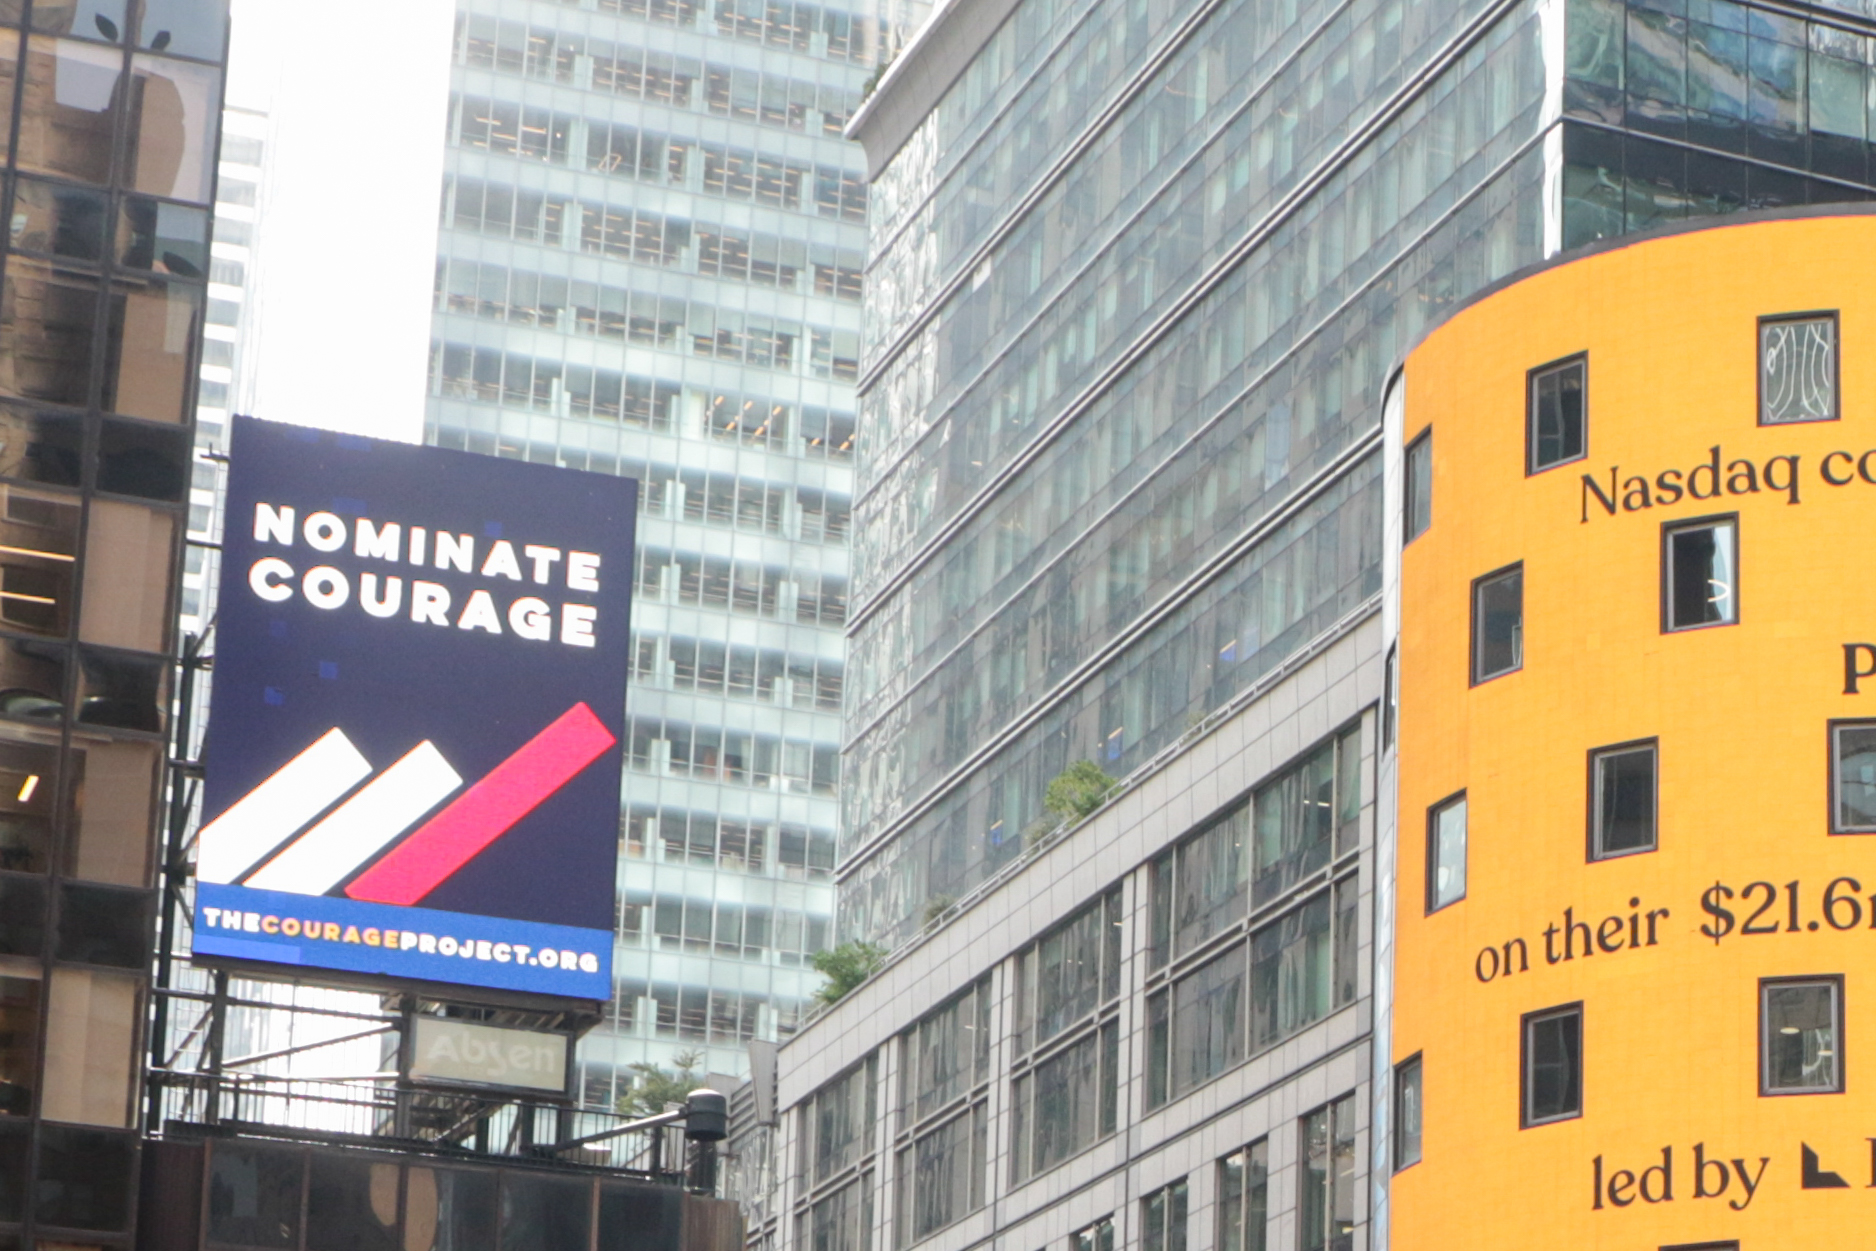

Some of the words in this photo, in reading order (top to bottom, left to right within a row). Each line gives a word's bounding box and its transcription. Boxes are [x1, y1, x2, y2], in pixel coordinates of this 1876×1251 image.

[1579, 445, 1801, 524] Nasdaq
[253, 502, 601, 593] NOMINATE
[248, 556, 599, 649] COURAGE
[202, 906, 599, 974] THECOURAGEPROJECT.ORG
[1475, 937, 1529, 983] on
[1542, 896, 1670, 965] their
[426, 1031, 556, 1077] Absen
[1592, 1145, 1674, 1211] led
[1692, 1142, 1770, 1211] by
